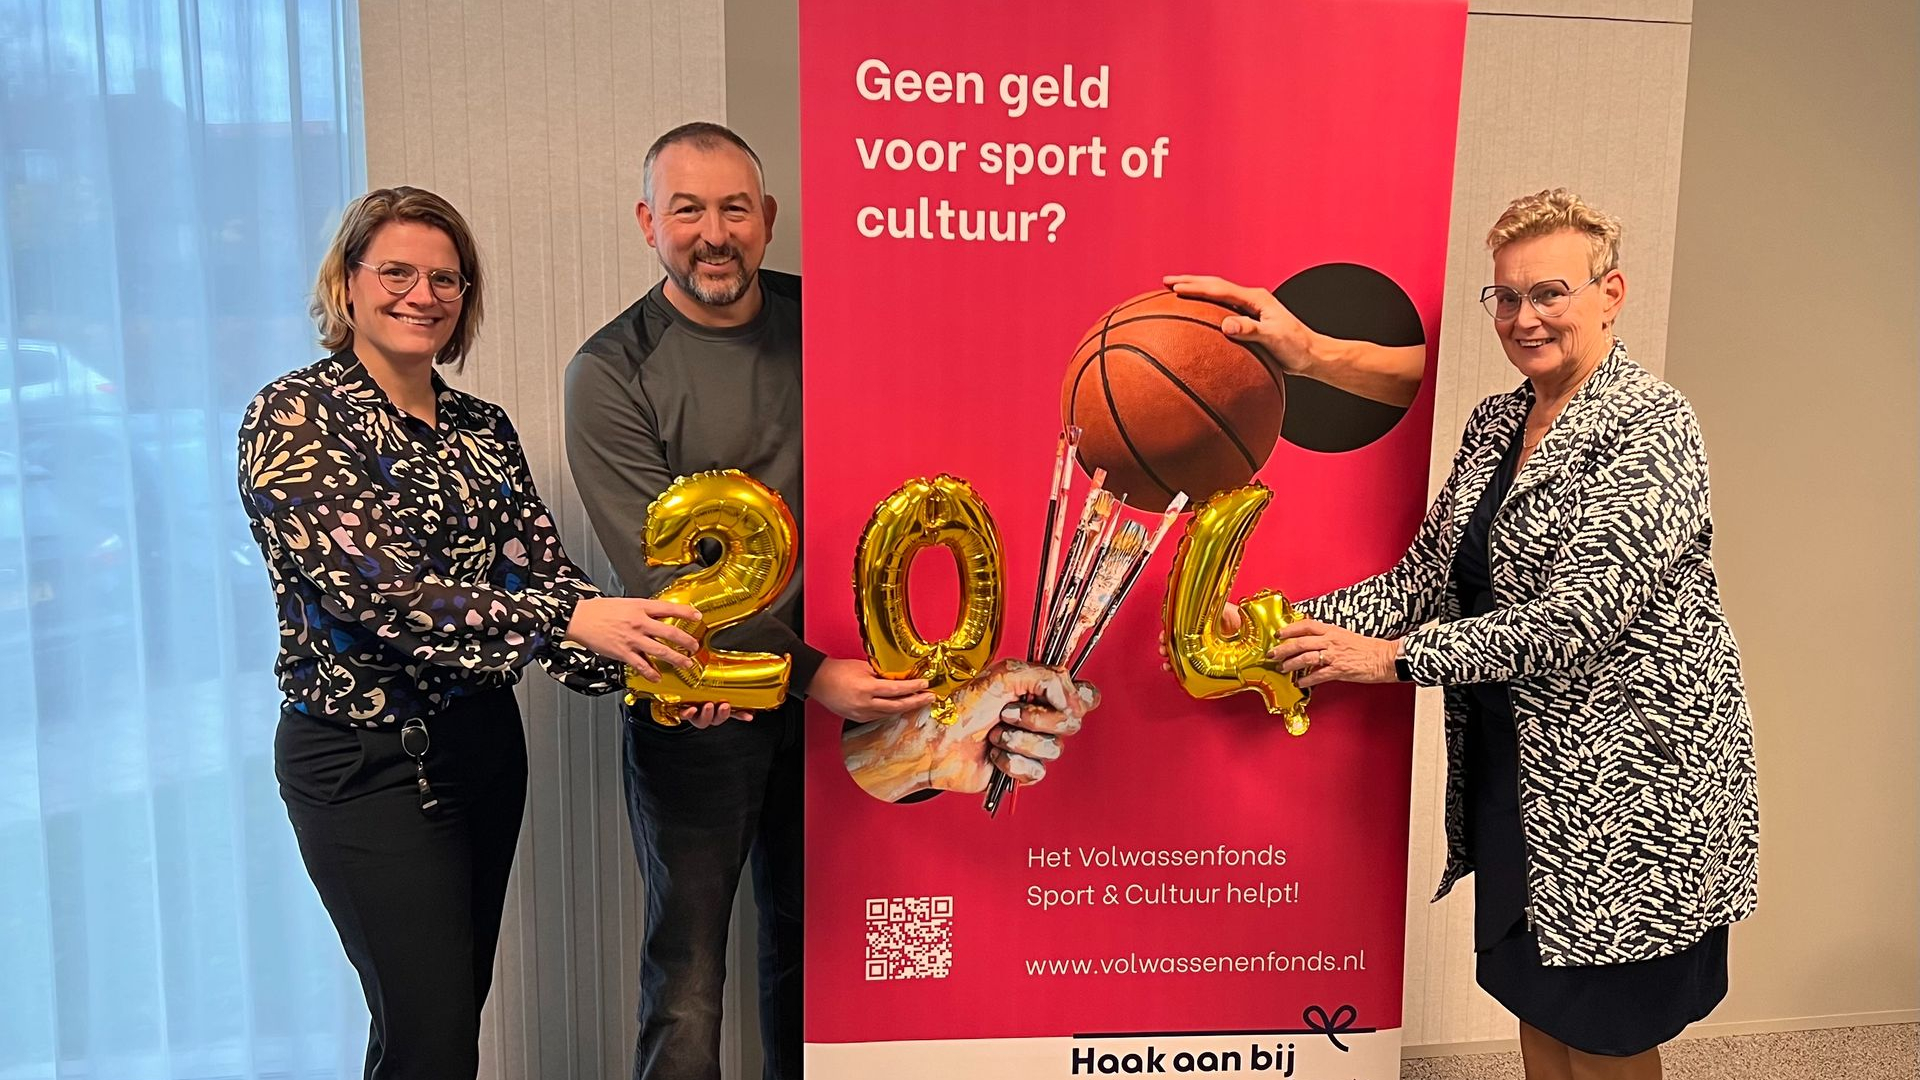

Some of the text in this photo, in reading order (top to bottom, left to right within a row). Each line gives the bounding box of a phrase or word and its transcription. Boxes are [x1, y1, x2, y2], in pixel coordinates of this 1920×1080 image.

[855, 57, 1111, 118] Geen geld
[855, 135, 1171, 186] voor sport of
[855, 196, 1067, 244] cultuur?
[1163, 481, 1308, 728] 4
[1027, 843, 1288, 869] Het Volwassenfonds
[1026, 880, 1300, 911] Sport & Cultuur helpt!
[1024, 948, 1367, 977] www.volwassenenfonds.nl
[1070, 1042, 1296, 1078] Haak aan bij
